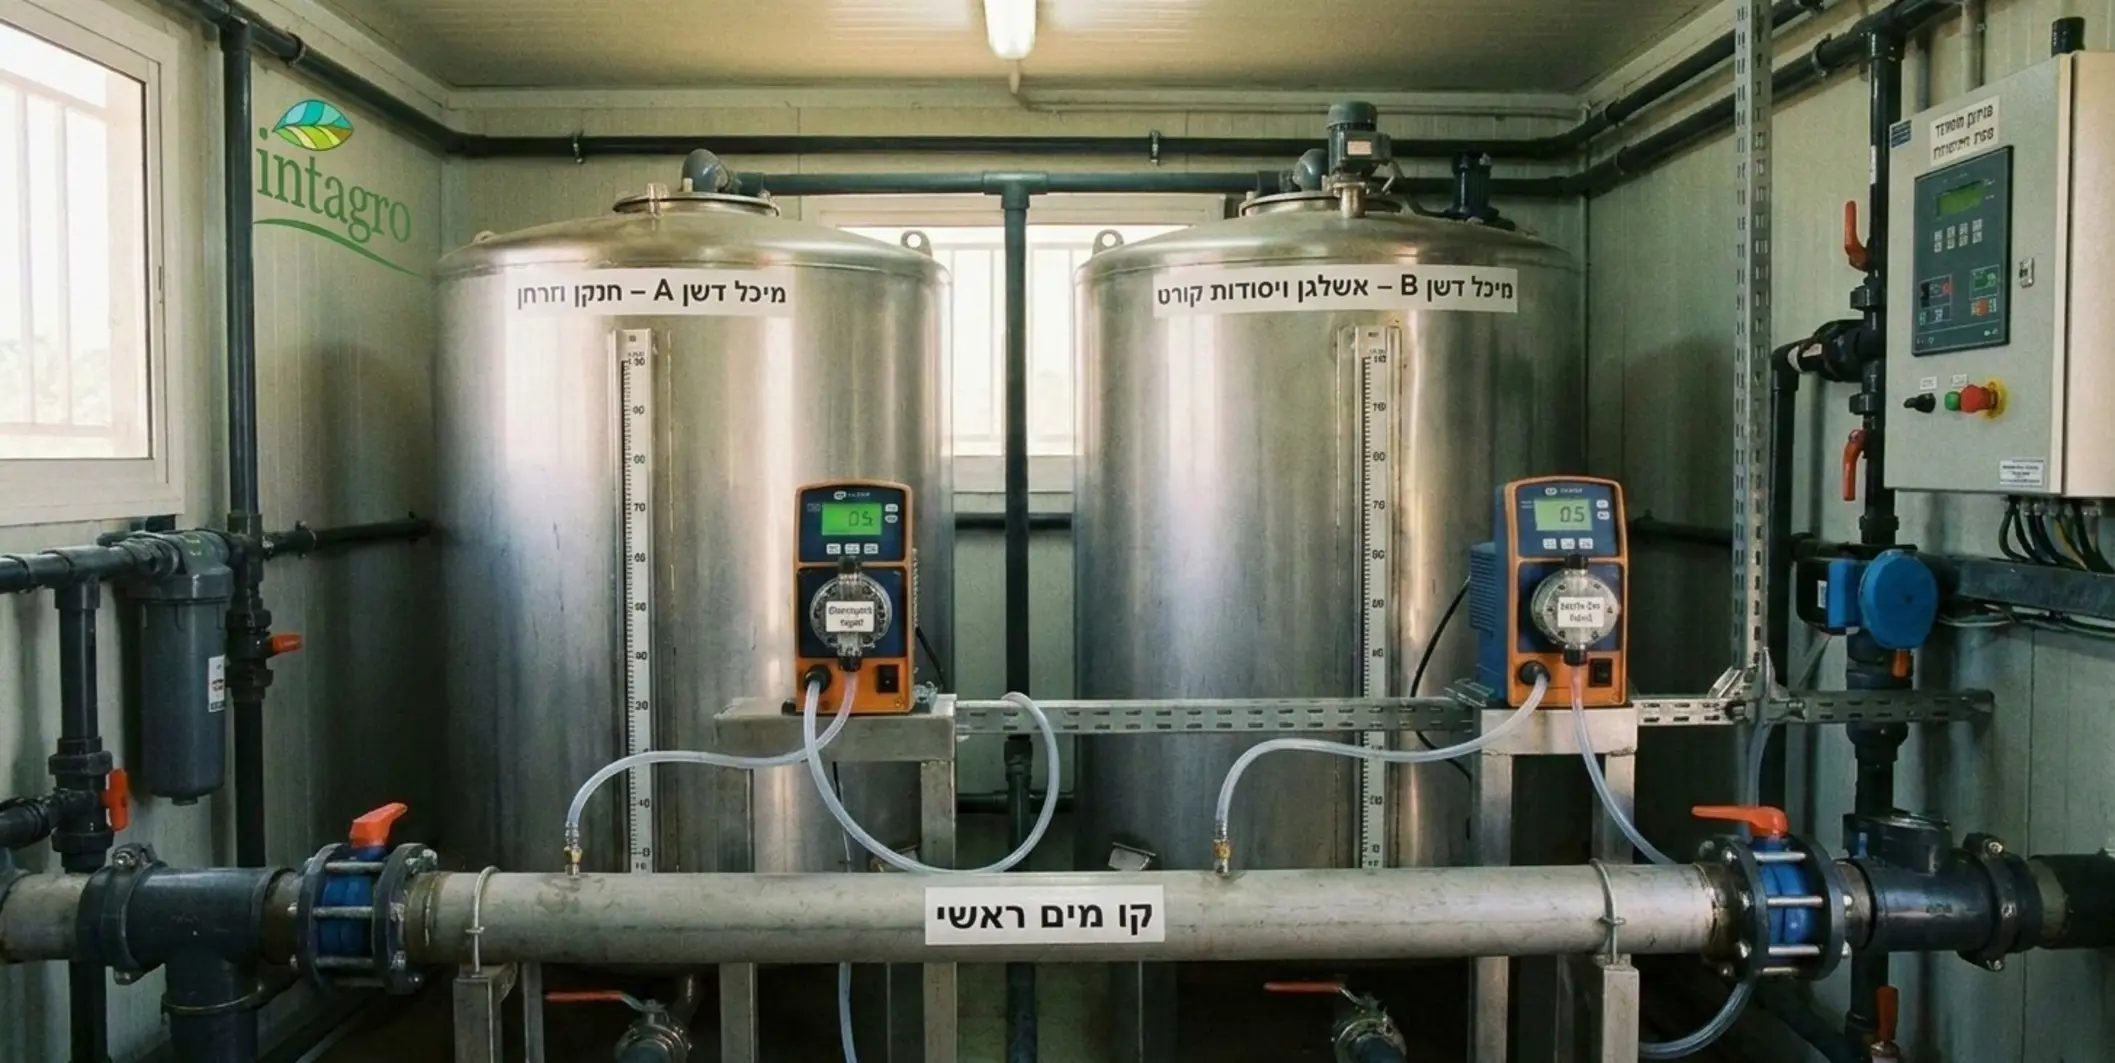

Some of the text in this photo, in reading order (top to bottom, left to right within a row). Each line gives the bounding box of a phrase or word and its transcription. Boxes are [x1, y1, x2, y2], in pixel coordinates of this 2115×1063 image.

[255, 127, 411, 244] intagro
[574, 283, 622, 307] חנקן
[653, 278, 674, 301] A
[682, 283, 727, 307] דשן
[734, 280, 787, 303] מיכל
[1157, 284, 1203, 307] קורט
[1210, 279, 1289, 301] ויסודות
[1298, 274, 1369, 303] אשלגן
[1401, 275, 1418, 295] B
[1426, 277, 1465, 302] דשן
[1471, 275, 1514, 299] מיכל
[937, 904, 1152, 935] קו מים ראשי
